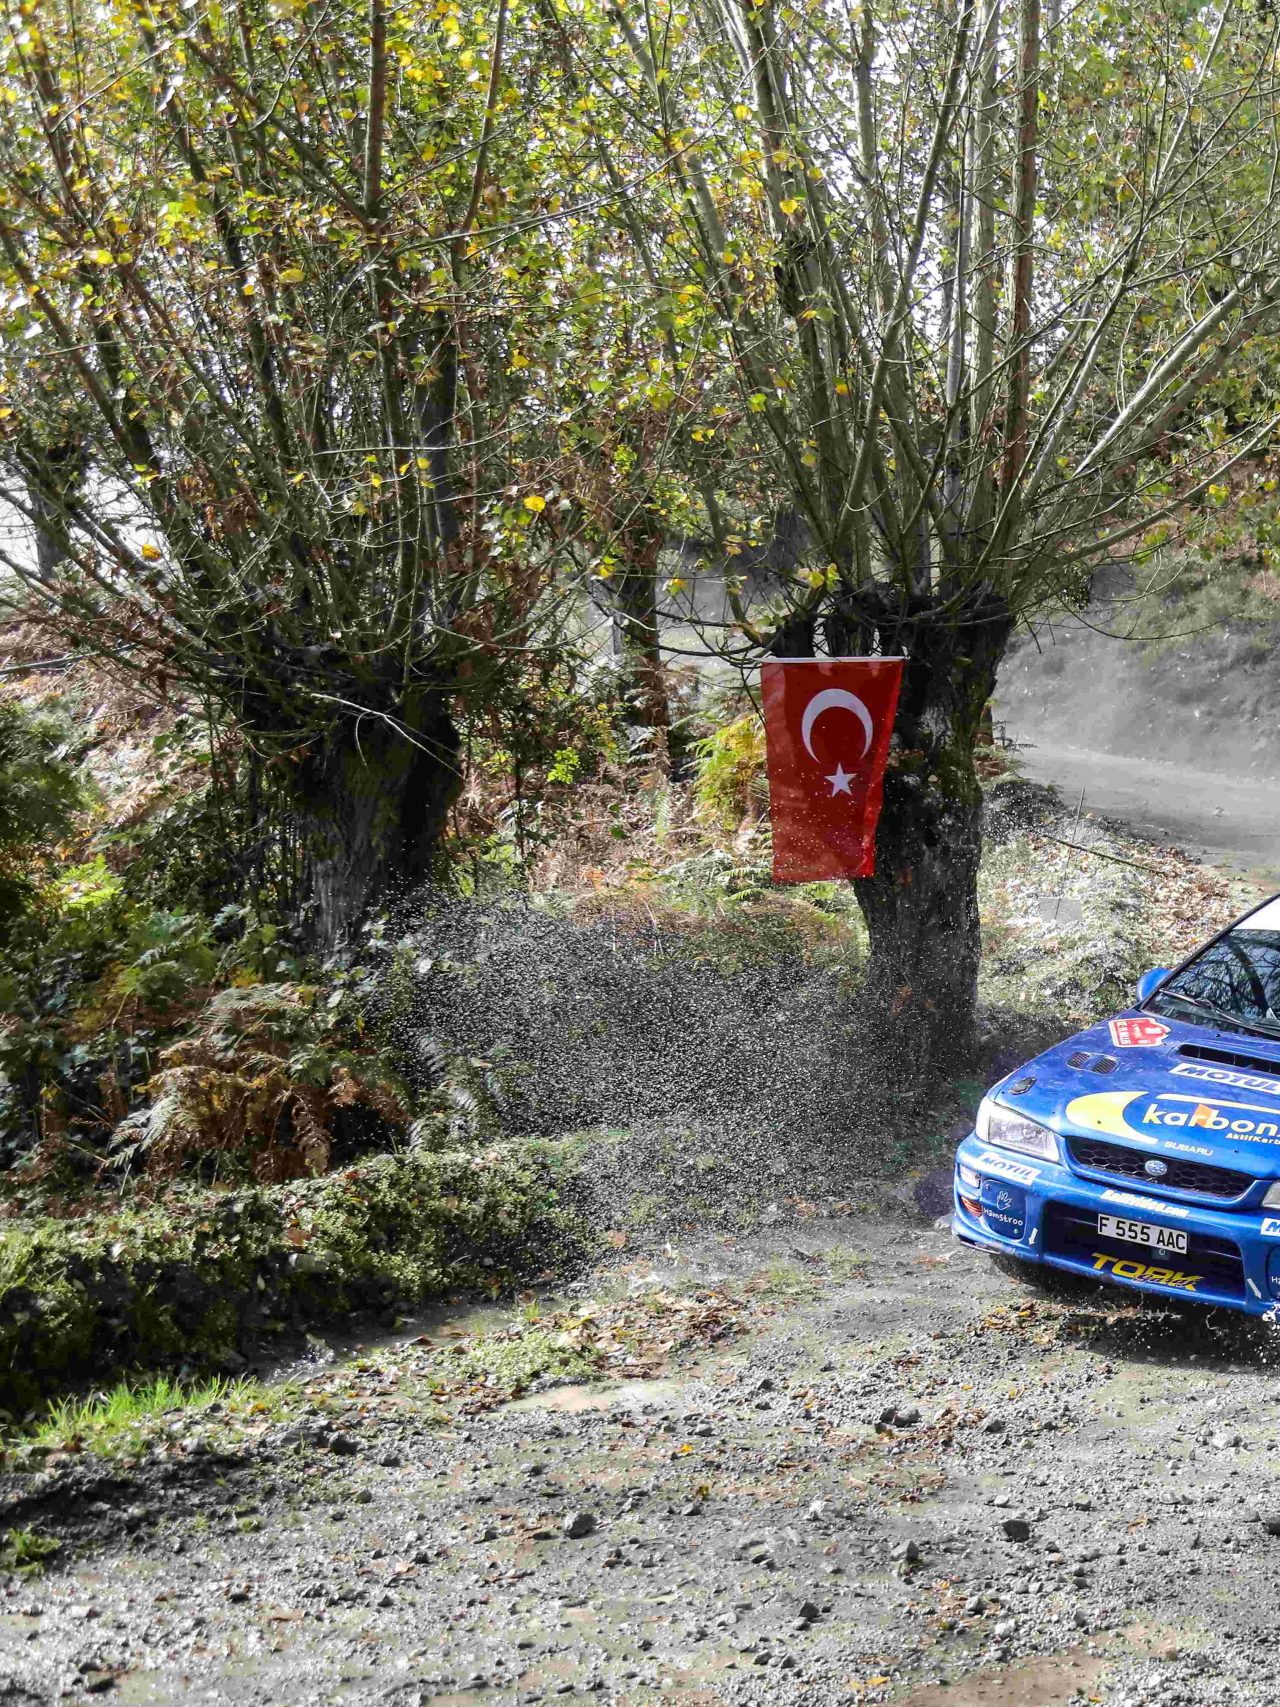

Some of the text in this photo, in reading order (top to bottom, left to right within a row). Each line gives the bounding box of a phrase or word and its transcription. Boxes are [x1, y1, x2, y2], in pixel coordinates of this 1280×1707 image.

[1178, 1065, 1280, 1093] MOTUL
[1163, 1140, 1215, 1157] SUBARU
[1099, 1216, 1186, 1250] F 555 AAC
[1092, 1252, 1204, 1291] TORK
